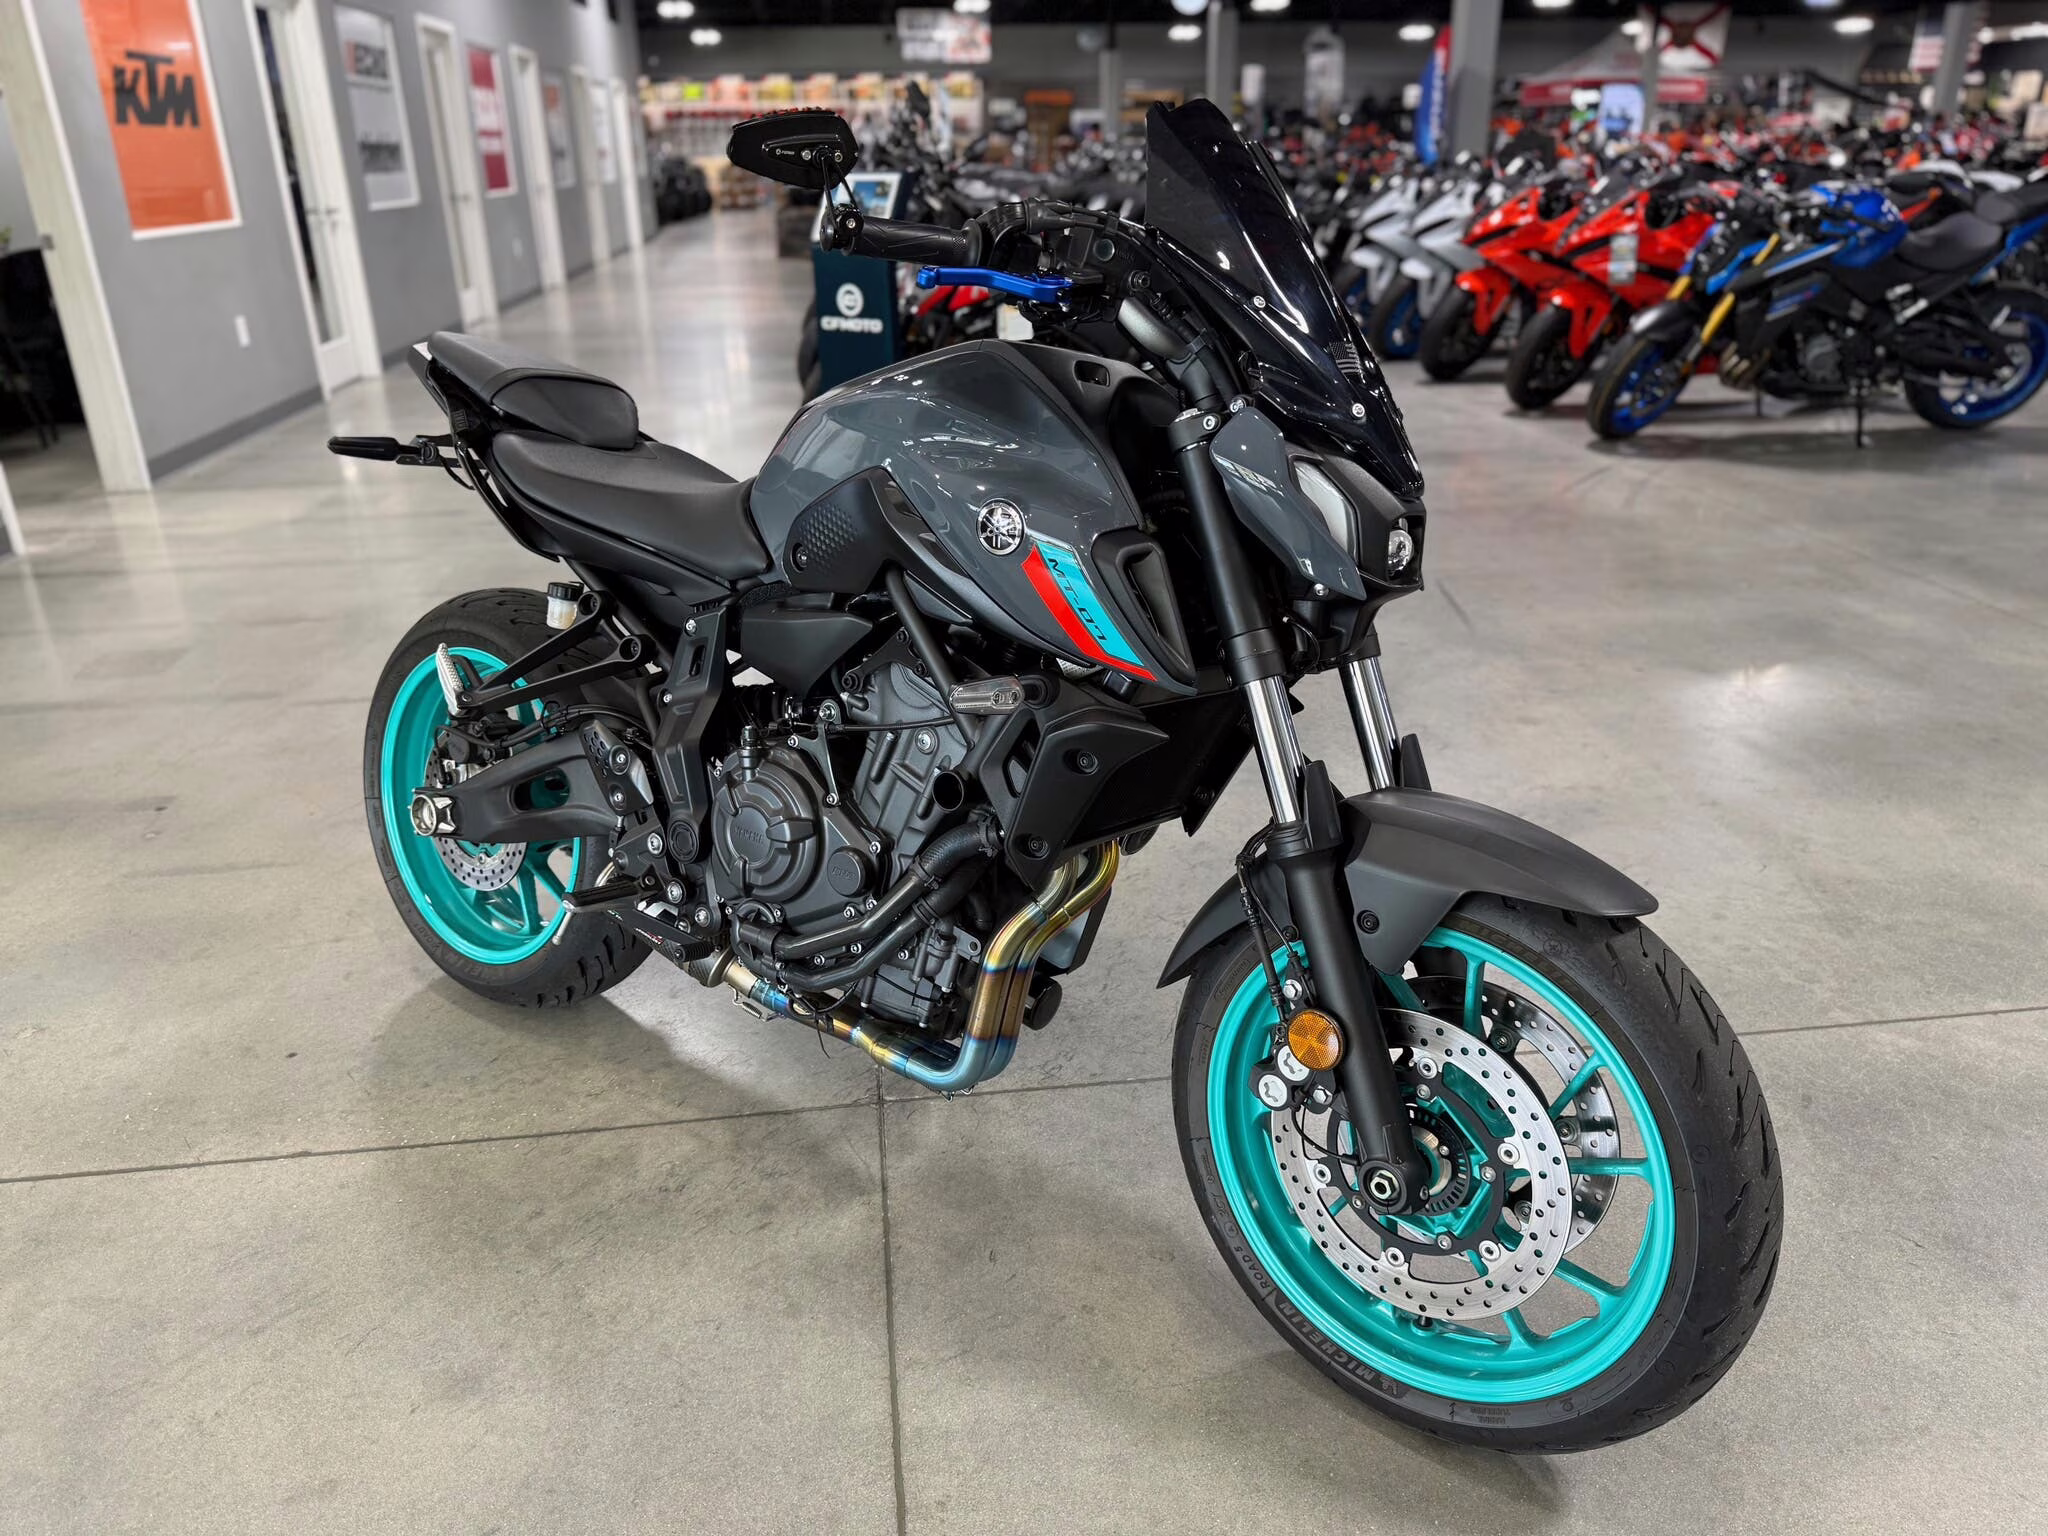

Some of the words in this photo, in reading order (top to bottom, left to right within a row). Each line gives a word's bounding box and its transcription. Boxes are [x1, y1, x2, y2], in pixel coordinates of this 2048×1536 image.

[113, 50, 199, 127] KTM
[1047, 557, 1107, 640] MT-07
[1242, 1255, 1271, 1288] ROAD
[1280, 1302, 1376, 1381] MICHELIN
